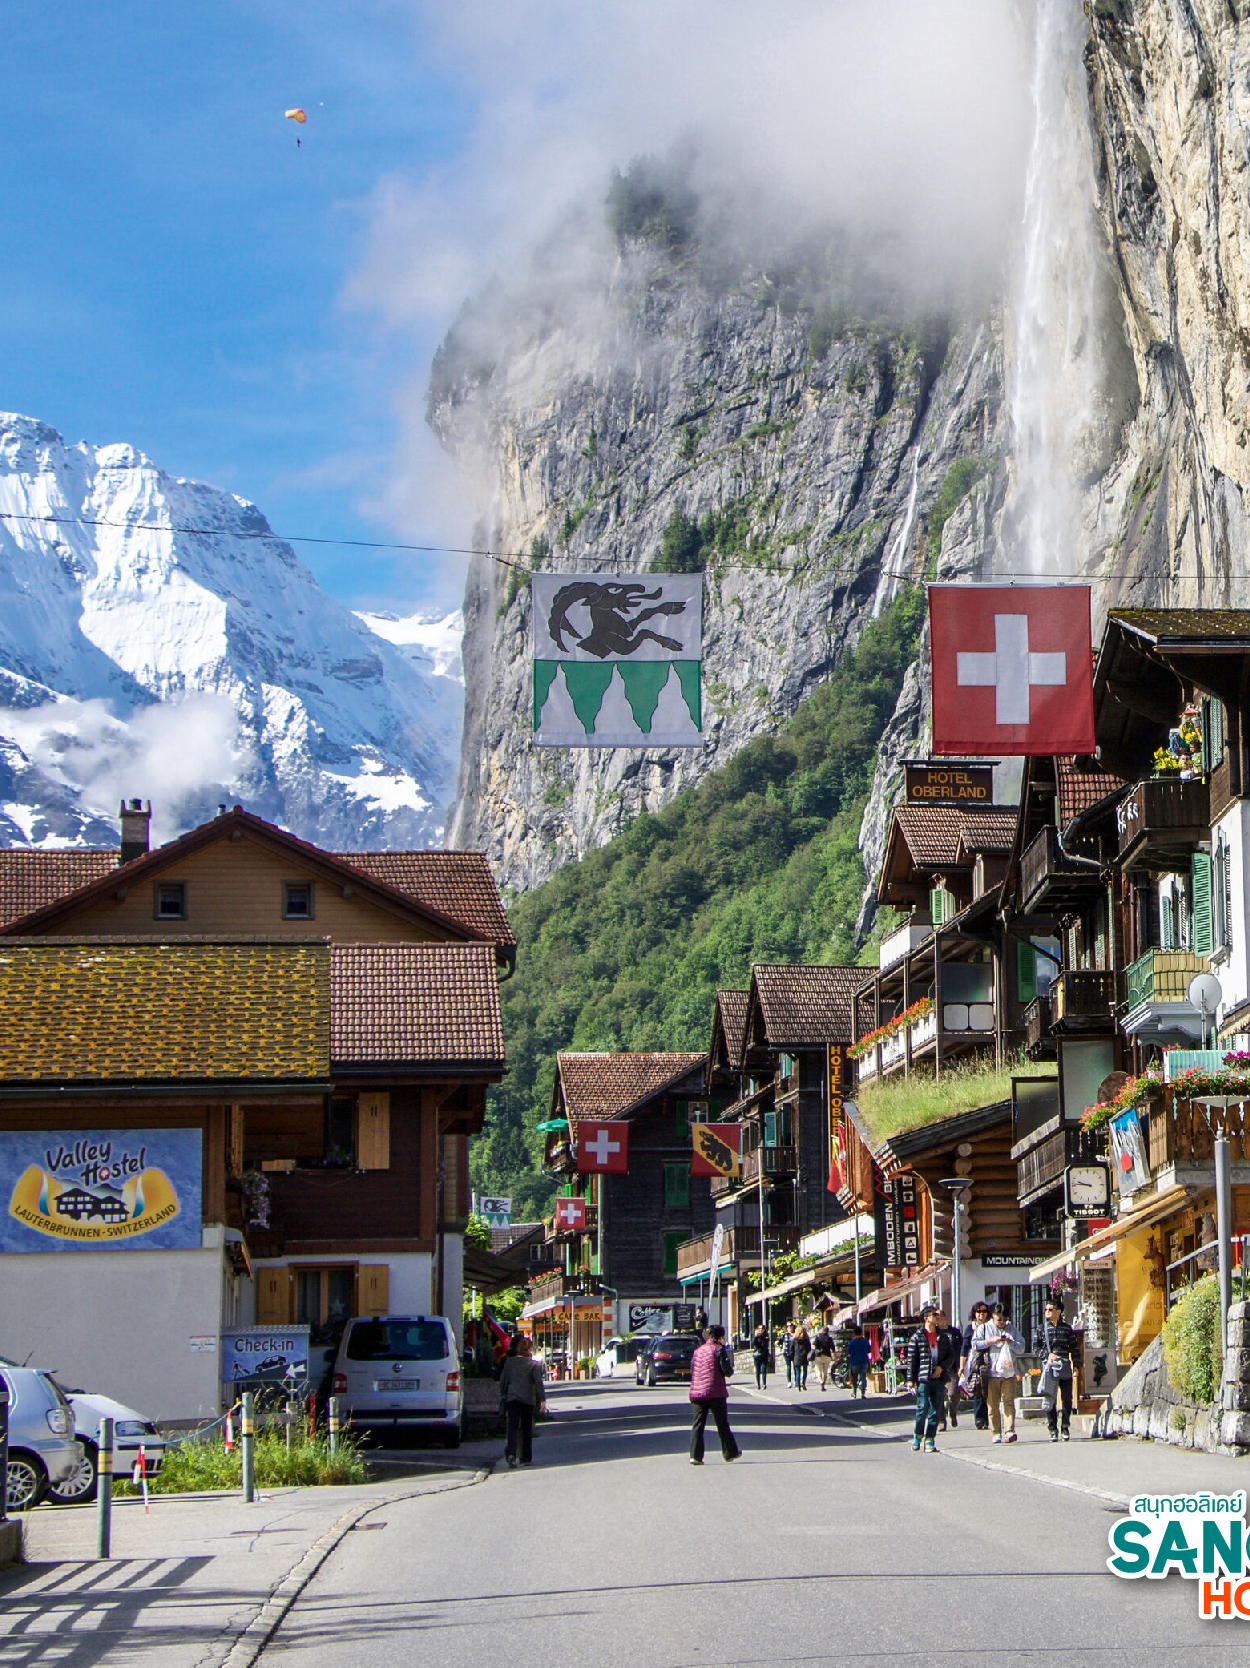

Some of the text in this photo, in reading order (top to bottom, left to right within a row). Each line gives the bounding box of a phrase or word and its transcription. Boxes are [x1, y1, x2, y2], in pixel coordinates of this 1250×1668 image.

[928, 772, 972, 784] HOTEL
[912, 785, 987, 798] OBERLAND
[830, 1046, 841, 1094] HOTEL
[46, 1140, 111, 1172] Valley
[80, 1147, 146, 1186] Hostel
[14, 1203, 176, 1237] LAUTERBRUNNEN SWITZERLAND
[883, 1176, 896, 1265] IMBODEN BI
[986, 1257, 1049, 1265] MOUNTAINBI
[584, 1312, 600, 1320] BAR
[234, 1338, 294, 1352] Check-in
